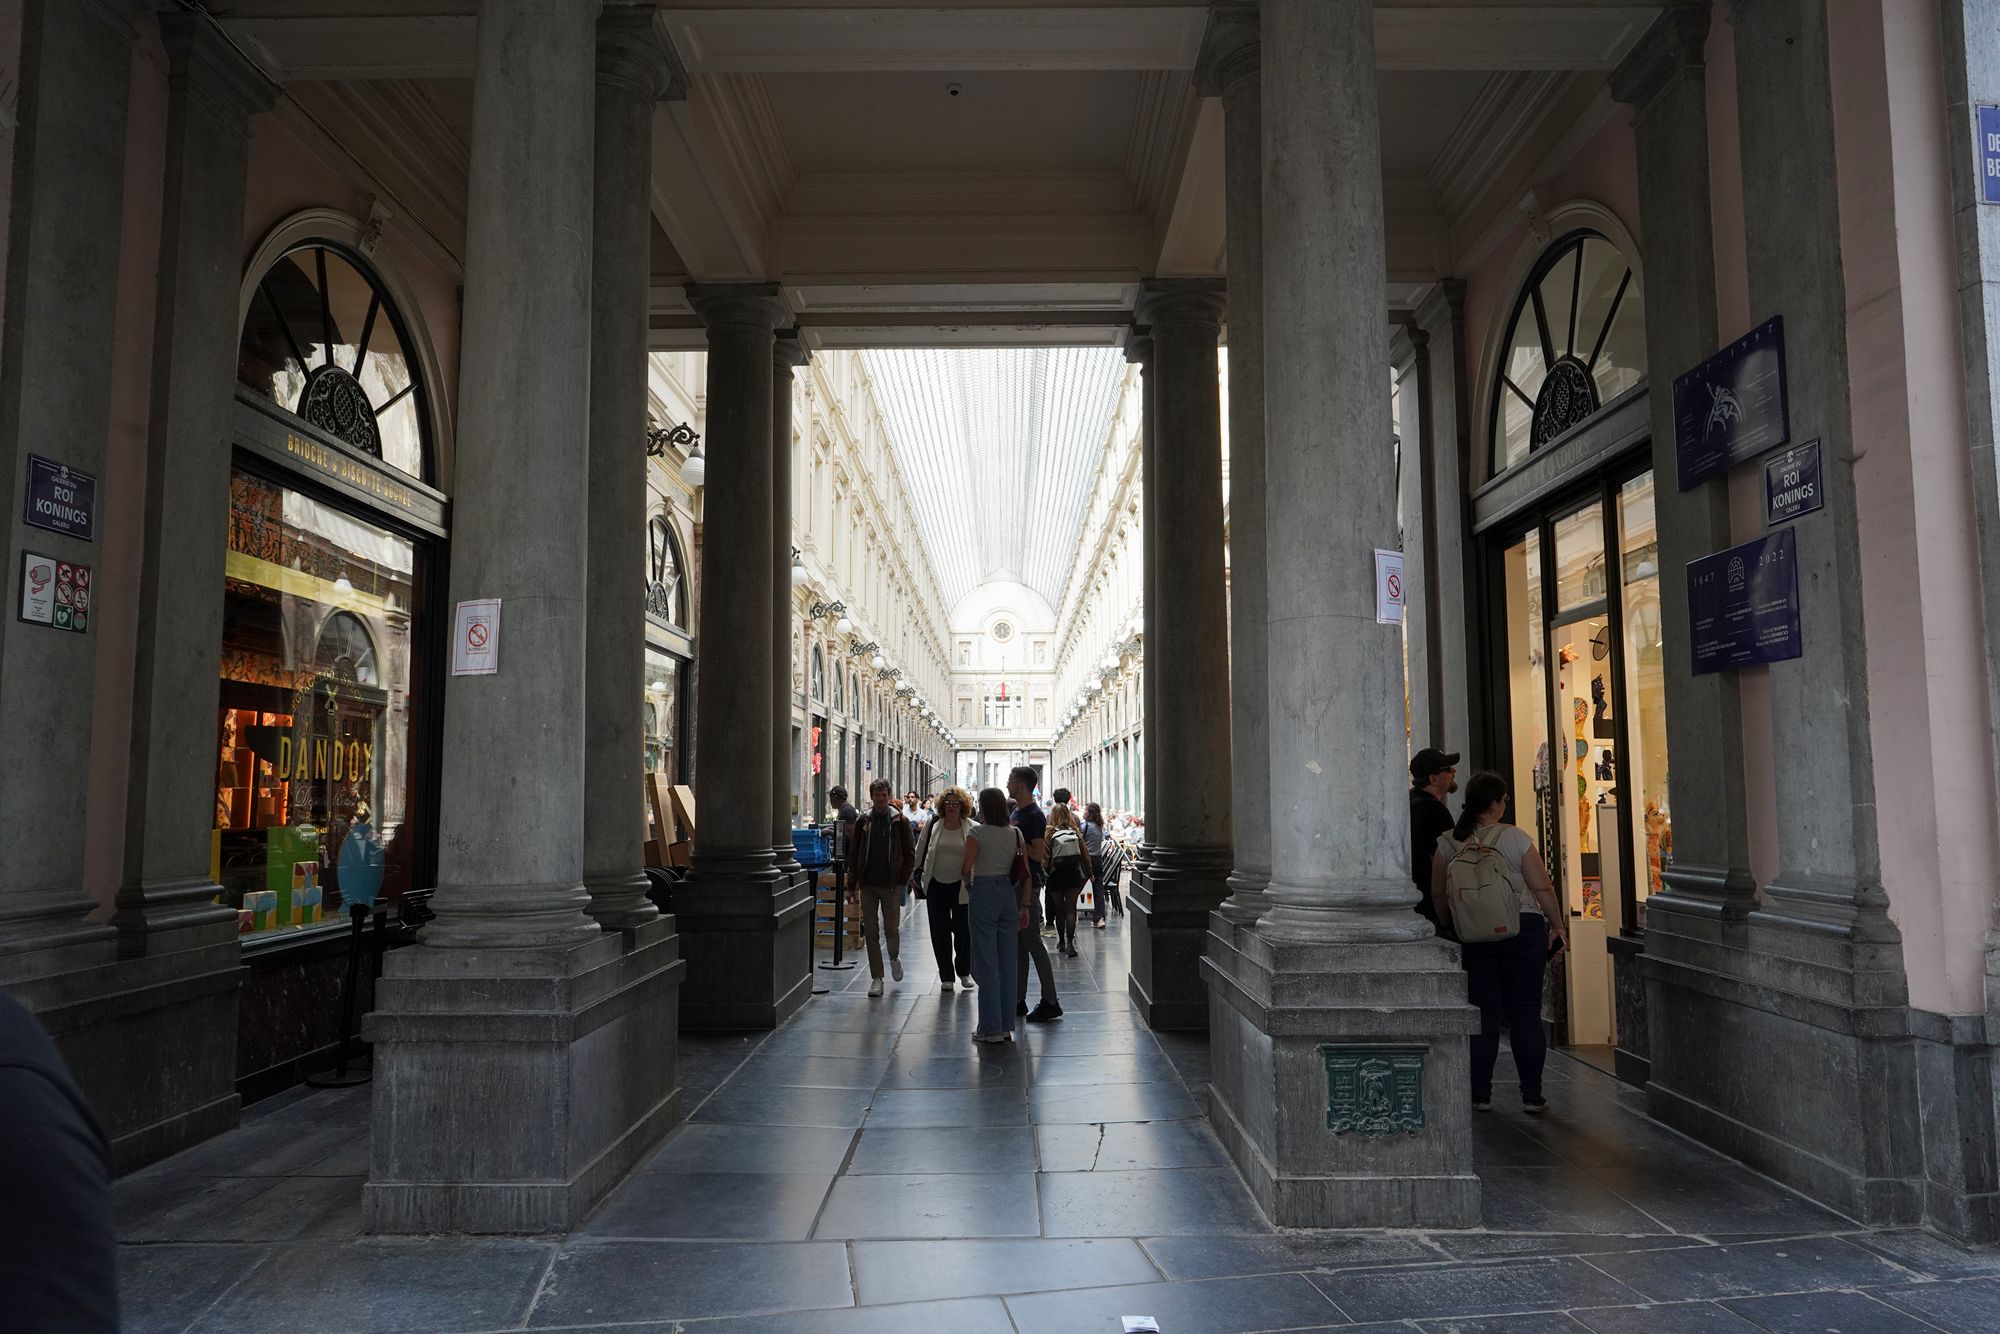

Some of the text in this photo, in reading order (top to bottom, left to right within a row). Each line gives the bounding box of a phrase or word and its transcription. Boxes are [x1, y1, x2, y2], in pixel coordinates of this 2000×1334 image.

[287, 433, 328, 469] BRIOCHE
[342, 461, 381, 493] BISCOTTE
[1783, 470, 1800, 488] ROI
[54, 486, 74, 504] ROI
[1772, 482, 1814, 510] KONINGS
[36, 498, 88, 526] KONINGS
[1693, 571, 1715, 588] 1847
[1759, 549, 1785, 567] 2022
[280, 736, 373, 783] DANDOY
